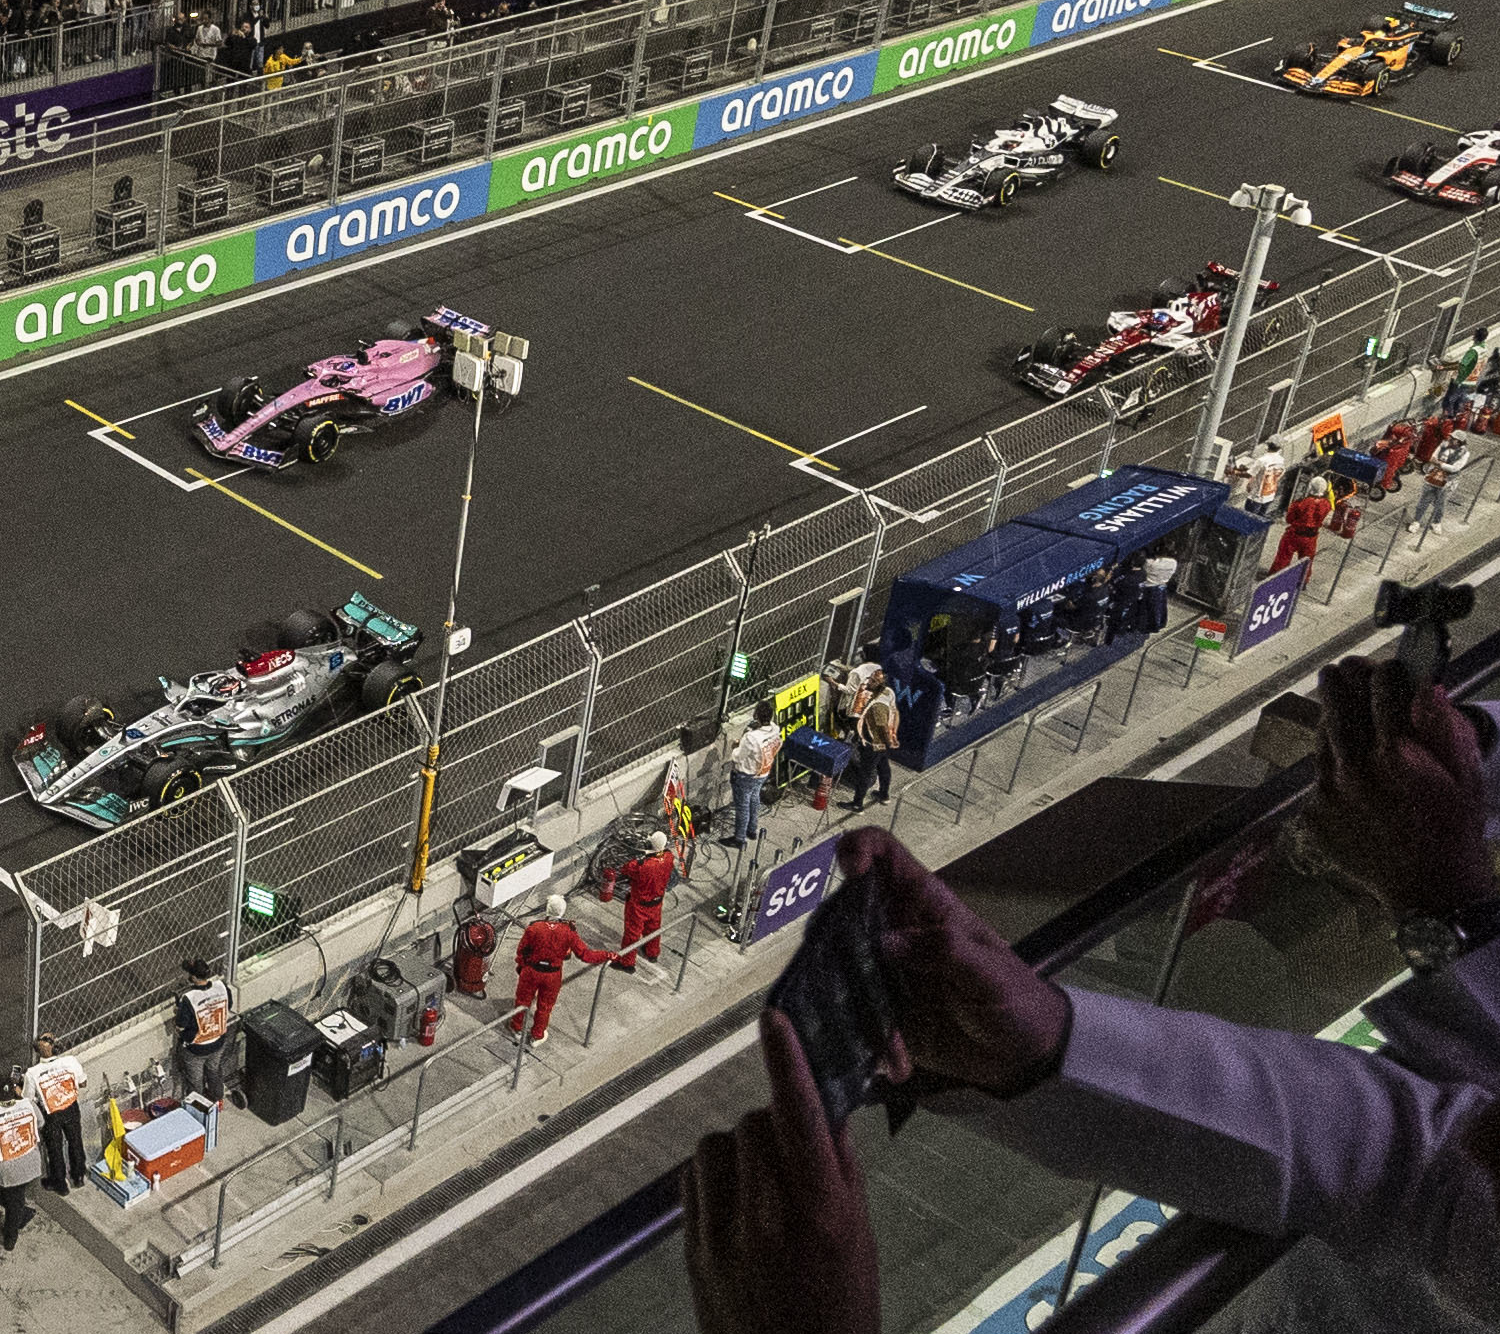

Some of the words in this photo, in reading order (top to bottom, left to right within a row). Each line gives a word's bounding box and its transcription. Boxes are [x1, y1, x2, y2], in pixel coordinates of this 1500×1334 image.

[899, 19, 1016, 79] aramco
[722, 67, 854, 133] aramco
[522, 121, 672, 191] aramco
[287, 183, 459, 262] aramco
[15, 254, 216, 343] aramco
[309, 394, 342, 408] MAPFRE
[384, 383, 425, 413] BWT
[243, 445, 282, 466] BWT
[1078, 482, 1160, 523] RACING
[1094, 483, 1198, 533] WILLIAMS
[1016, 577, 1067, 611] WILLIAMS
[1249, 591, 1289, 632] stc
[268, 651, 294, 671] INEOS
[271, 695, 317, 727] PETRONAS
[788, 683, 808, 702] ALEX
[129, 797, 150, 813] IWC
[766, 868, 821, 917] stc
